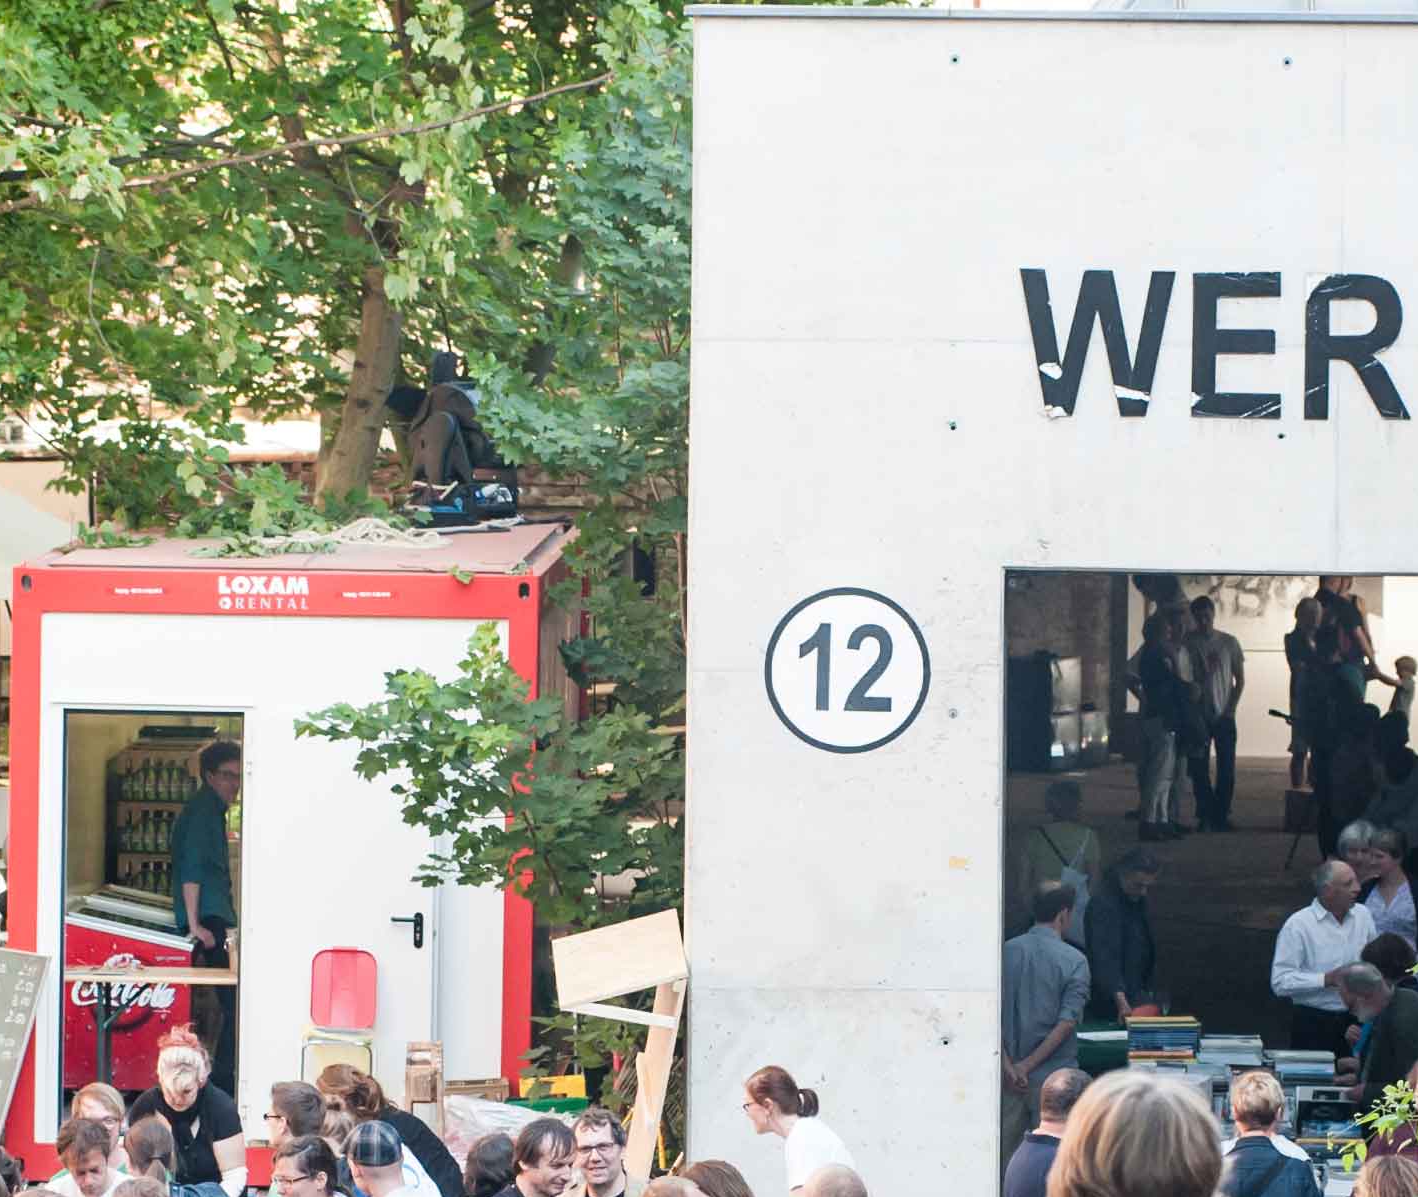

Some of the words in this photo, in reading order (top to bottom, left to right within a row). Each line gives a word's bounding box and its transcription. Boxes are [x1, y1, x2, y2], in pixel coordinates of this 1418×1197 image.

[218, 576, 310, 595] LOXAM
[234, 597, 309, 610] RENTAL
[799, 623, 893, 712] 12
